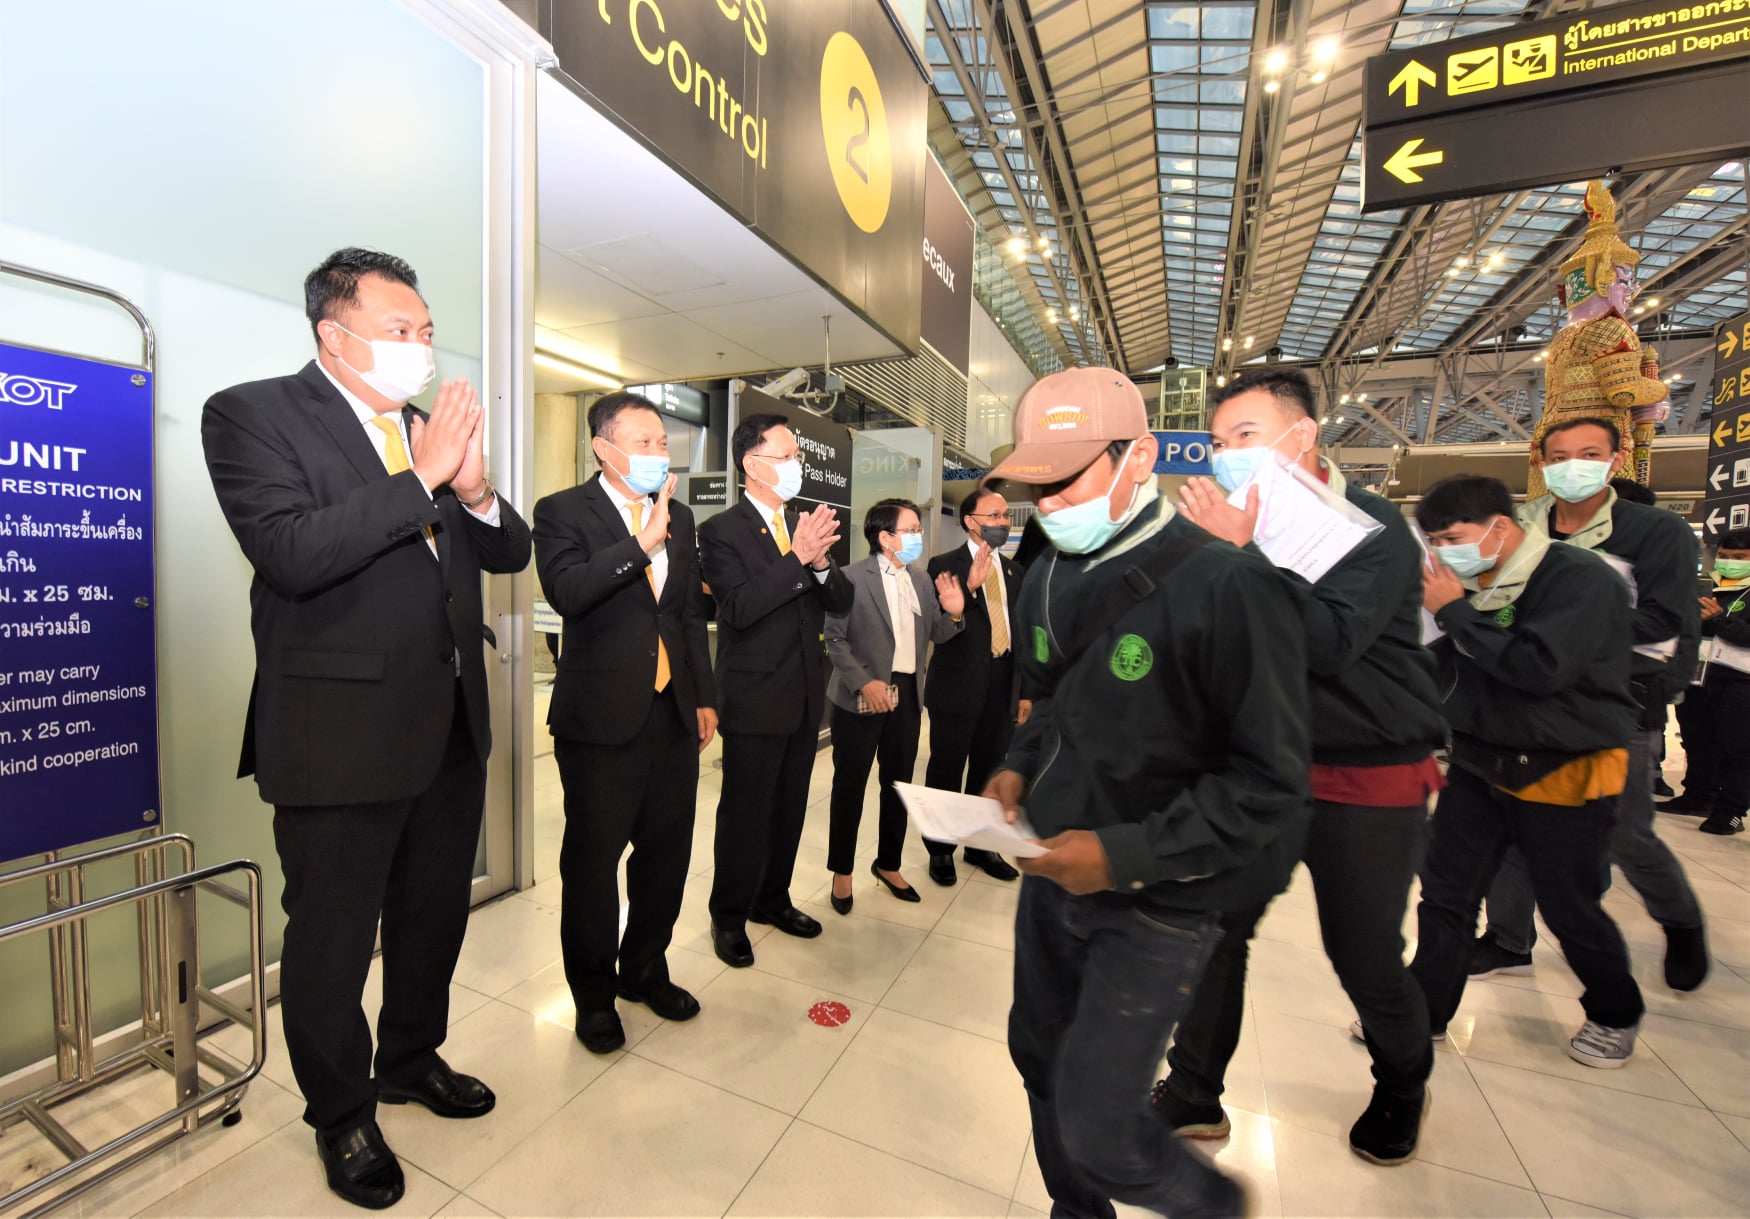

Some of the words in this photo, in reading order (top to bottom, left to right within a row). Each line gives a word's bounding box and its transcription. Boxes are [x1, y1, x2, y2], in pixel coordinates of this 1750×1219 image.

[1564, 41, 1677, 75] International
[1683, 26, 1750, 52] Depart
[629, 0, 767, 170] Control
[846, 86, 870, 185] 2
[923, 237, 955, 294] ecaux
[0, 440, 87, 472] UNIT
[1, 478, 142, 502] RESTRICTION
[804, 463, 824, 482] Pass
[825, 469, 848, 488] Holder
[23, 589, 38, 602] x
[43, 585, 69, 602] 25
[77, 585, 114, 601] ซม.
[19, 669, 55, 685] may
[60, 665, 100, 681] carry
[0, 696, 57, 713] ximum
[62, 685, 147, 706] dimensions
[22, 728, 32, 741] x
[38, 721, 60, 739] 25
[66, 720, 96, 735] cm.
[0, 755, 37, 776] kind
[43, 741, 138, 767] cooperation
